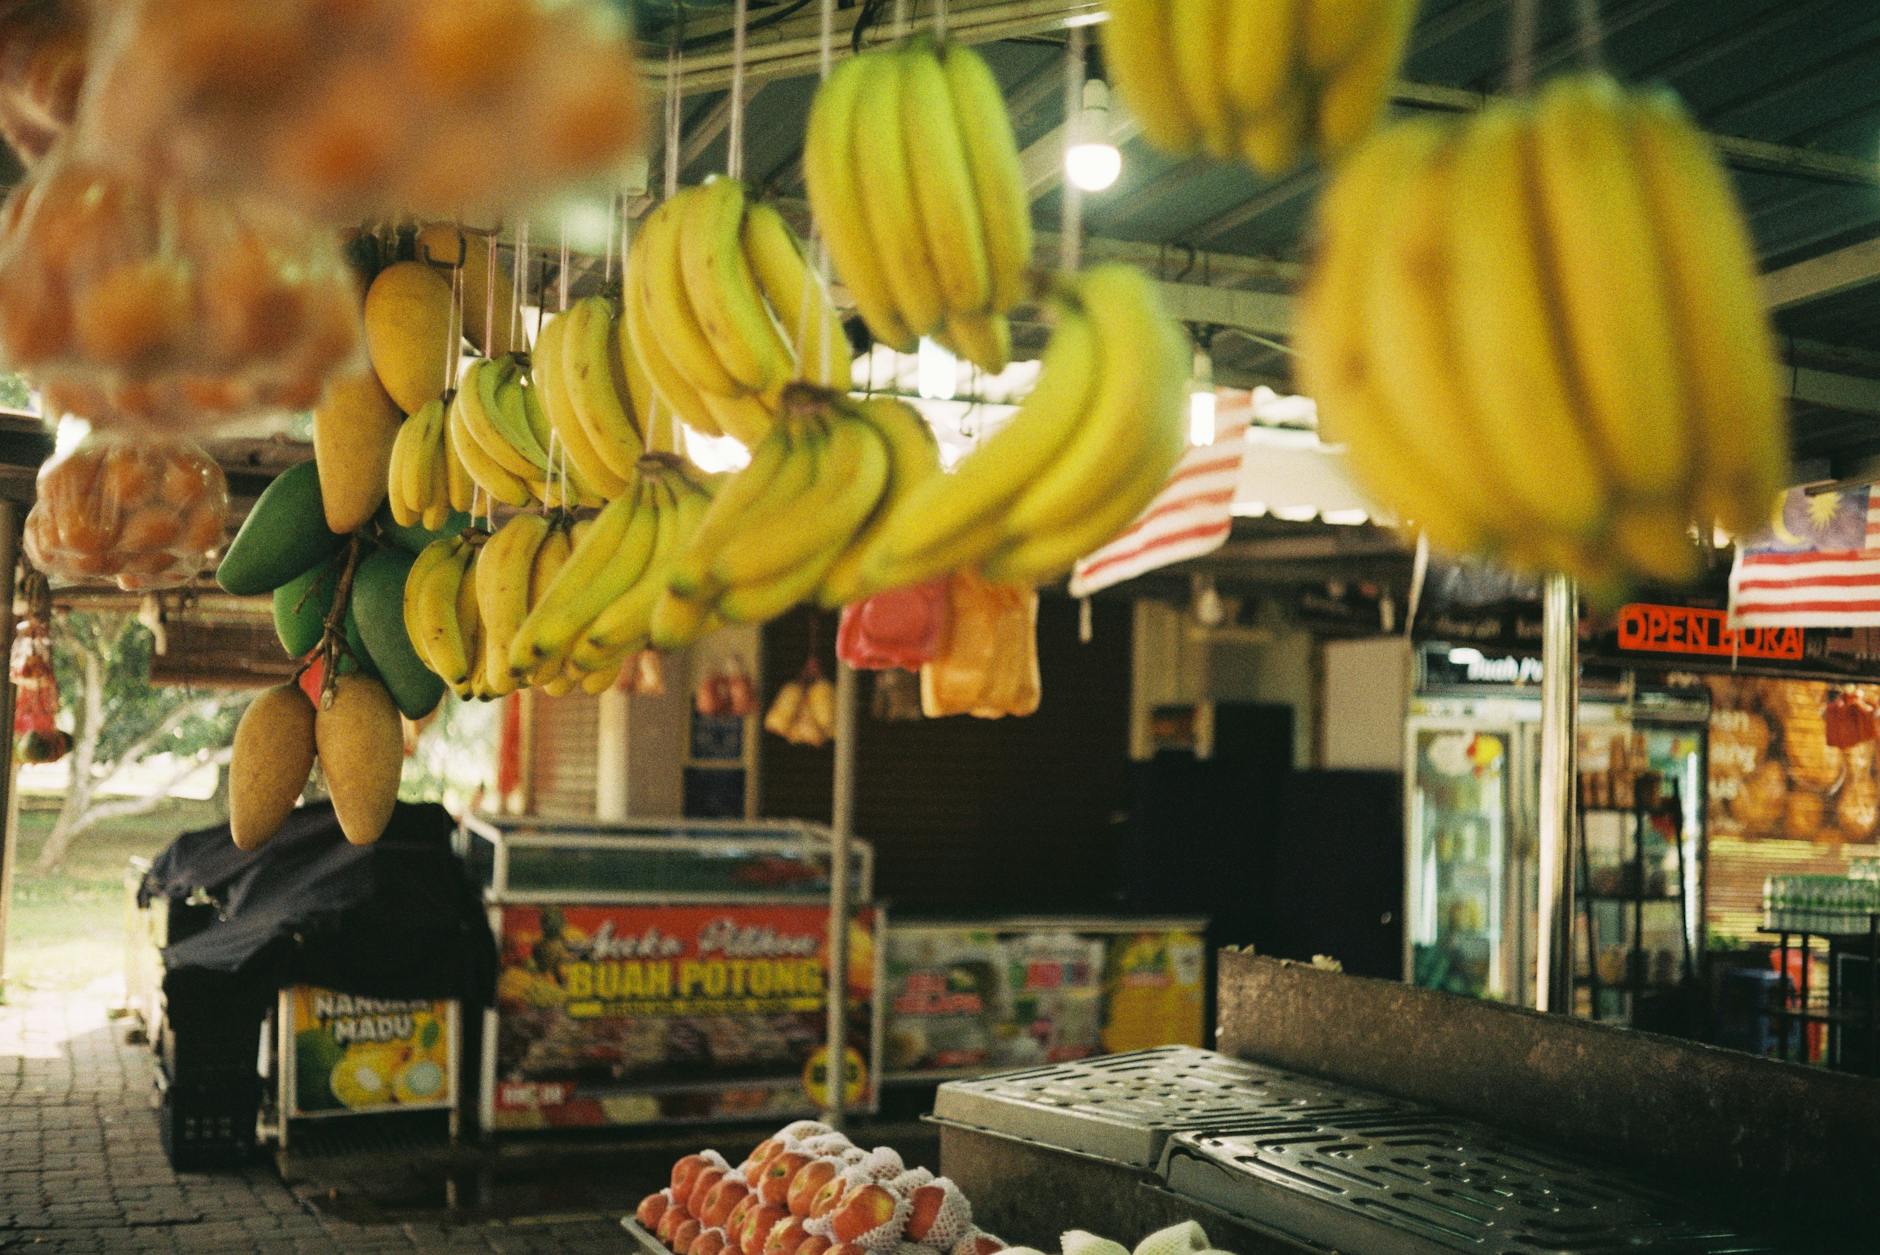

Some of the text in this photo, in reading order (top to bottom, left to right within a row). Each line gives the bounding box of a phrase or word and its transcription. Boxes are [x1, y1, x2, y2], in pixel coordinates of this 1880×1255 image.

[1622, 606, 1709, 648] OPEN
[567, 957, 822, 998] BUAH POTONG
[334, 1015, 412, 1042] MADU
